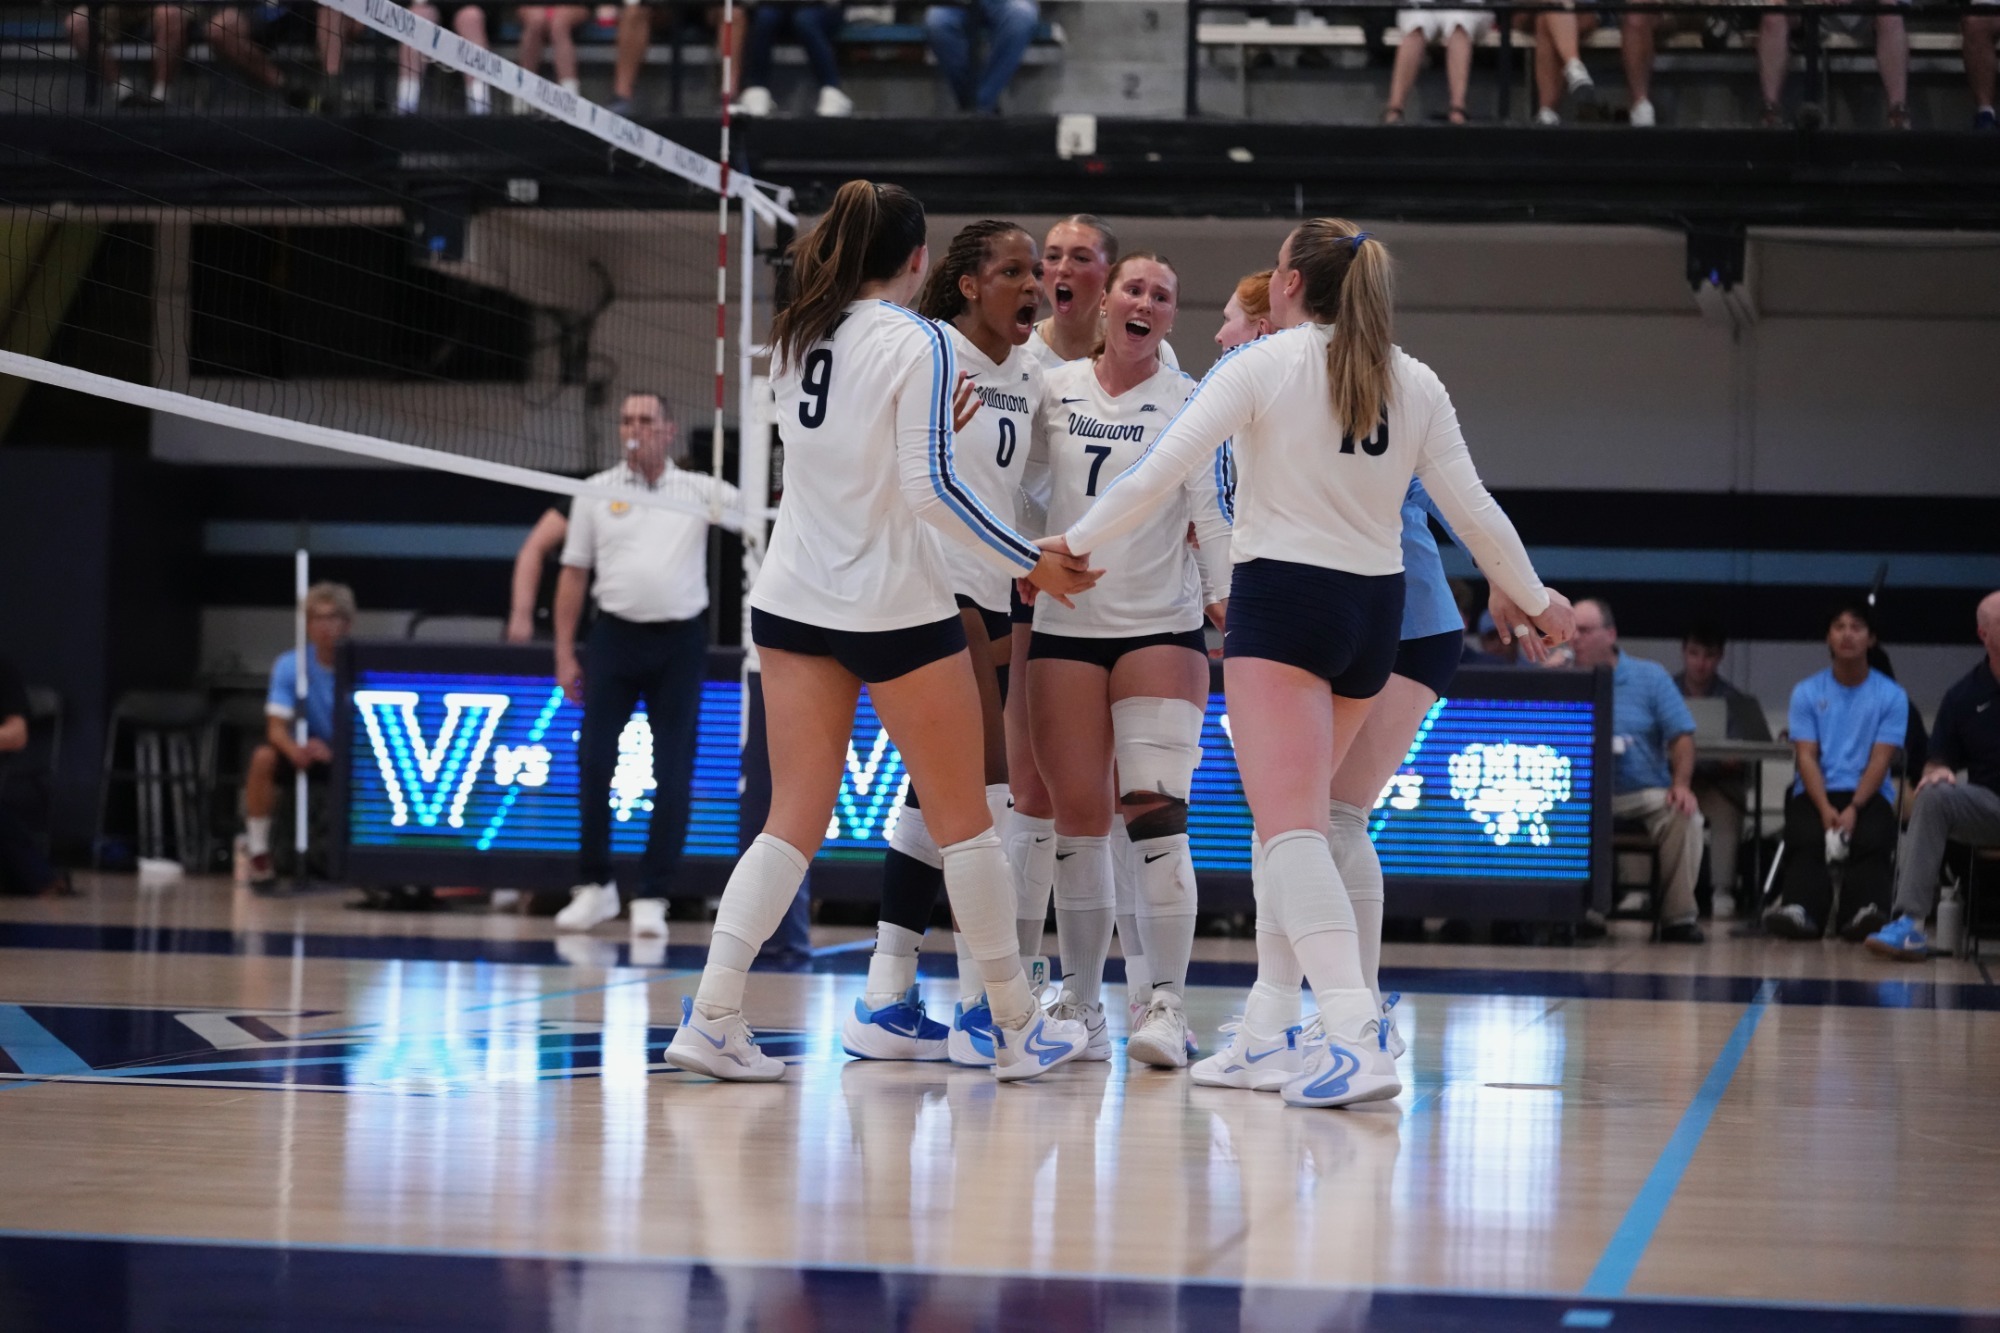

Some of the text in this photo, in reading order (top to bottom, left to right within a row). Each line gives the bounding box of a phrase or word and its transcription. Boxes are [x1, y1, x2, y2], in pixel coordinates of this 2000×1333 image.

[799, 349, 833, 429] 9
[974, 386, 1029, 414] Villanova
[996, 417, 1016, 468] 0
[1068, 412, 1144, 442] Villanova
[1084, 444, 1112, 497] 7
[354, 691, 510, 828] V
